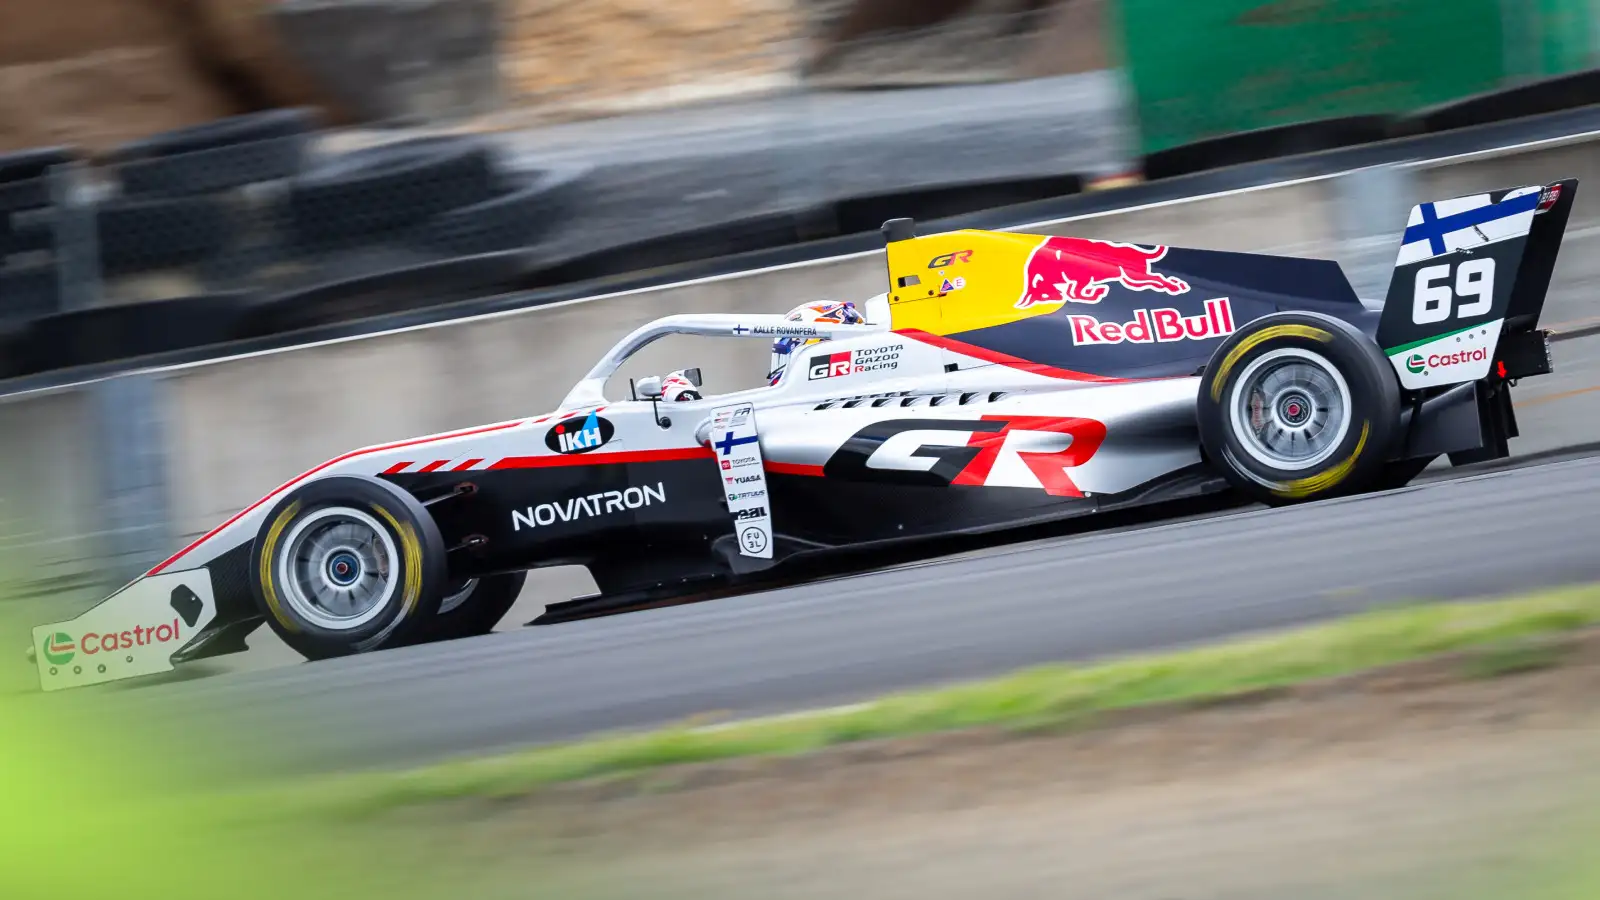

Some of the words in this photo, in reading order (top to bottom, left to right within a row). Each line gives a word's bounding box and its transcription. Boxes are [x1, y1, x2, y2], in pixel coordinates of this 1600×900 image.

[928, 250, 973, 269] GR
[1412, 257, 1496, 325] 69
[753, 326, 775, 334] KALLE
[1068, 310, 1151, 345] Red
[1152, 298, 1234, 340] Bull
[854, 353, 899, 365] GAZOO
[855, 344, 904, 357] TOYOTA
[1428, 347, 1487, 368] Castrol
[810, 360, 851, 379] GR
[854, 361, 898, 373] Racing
[823, 415, 1106, 498] GR
[734, 475, 761, 484] YUASA
[512, 482, 666, 531] NOVATRON
[80, 618, 180, 655] Castrol
